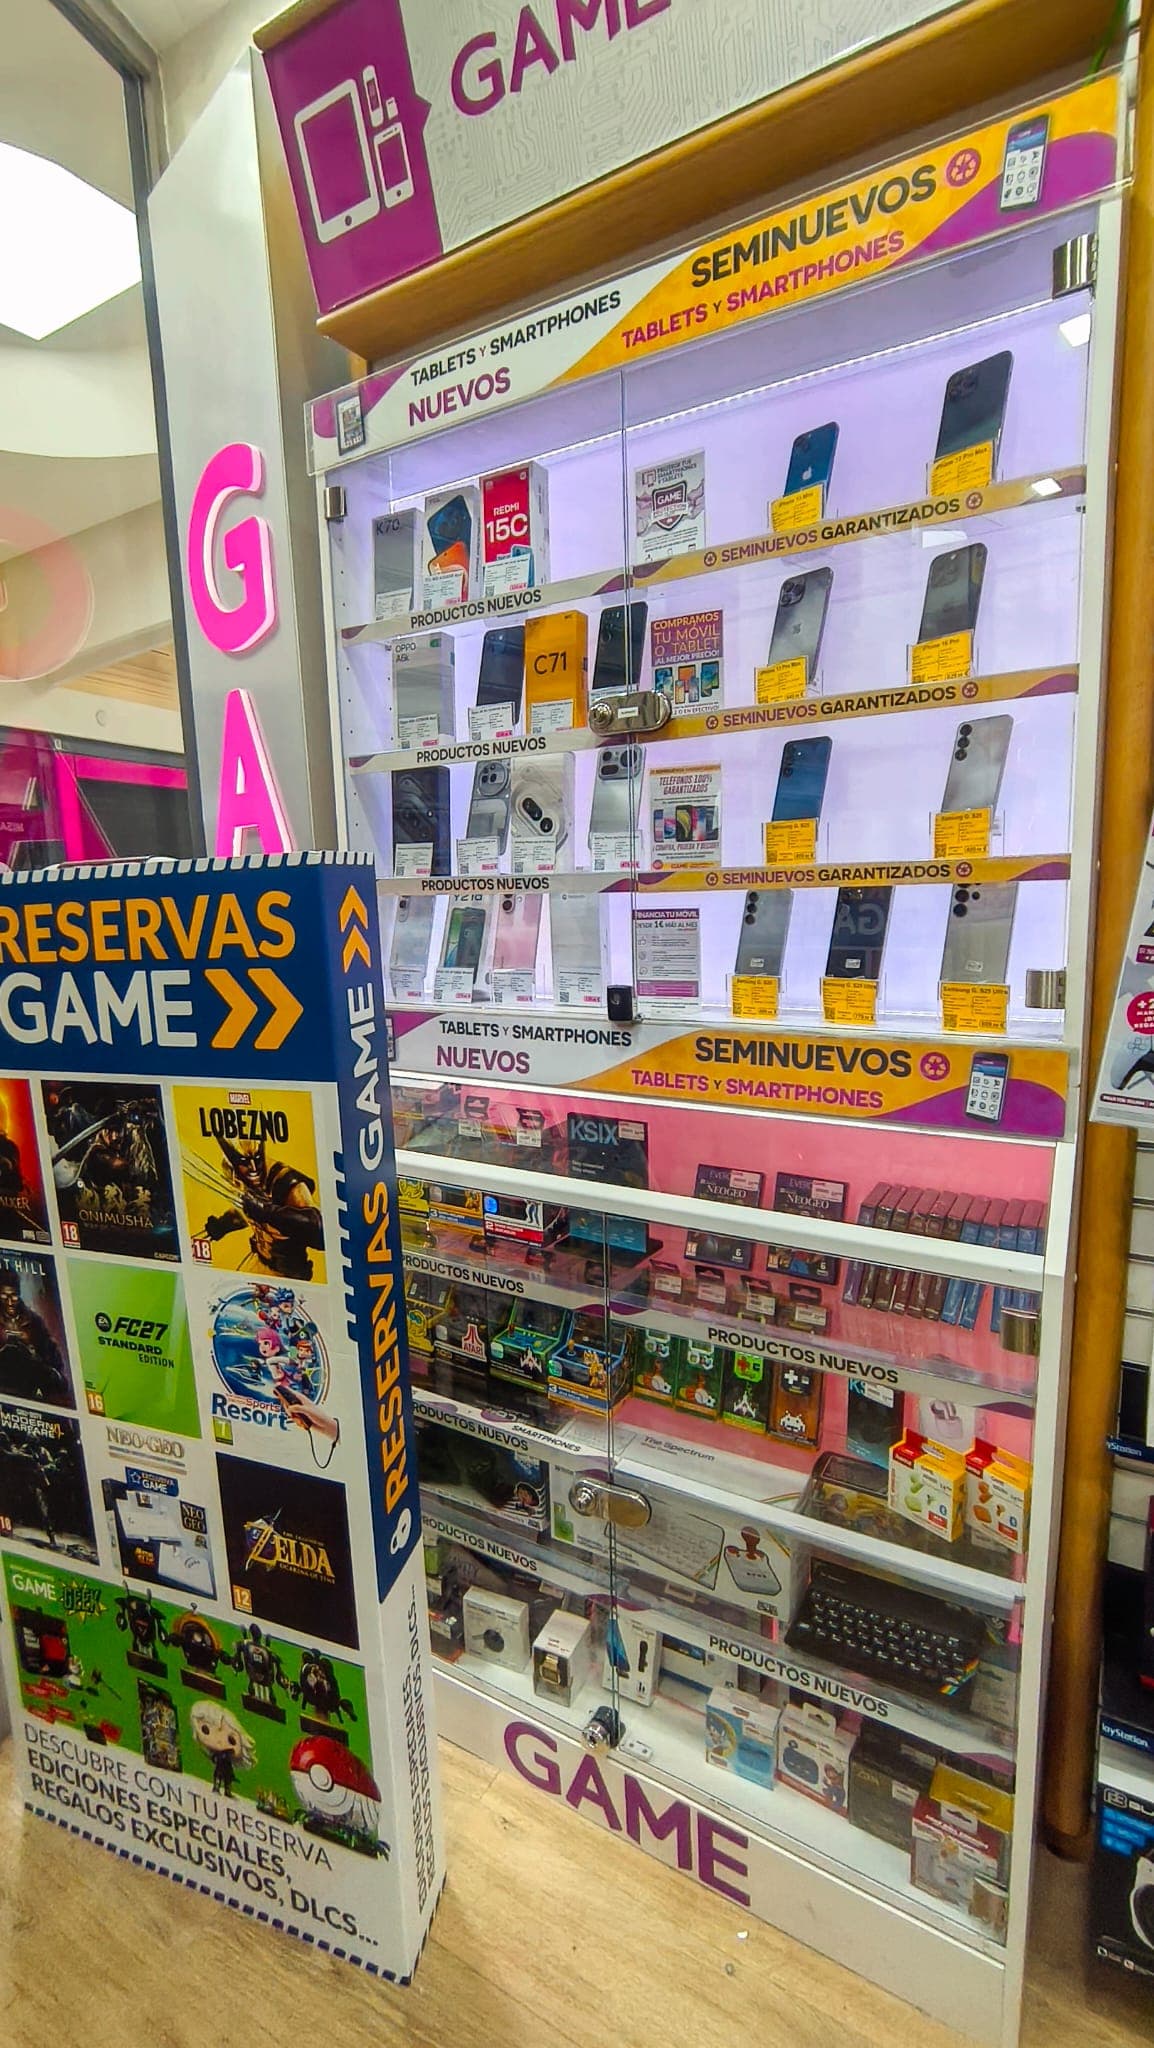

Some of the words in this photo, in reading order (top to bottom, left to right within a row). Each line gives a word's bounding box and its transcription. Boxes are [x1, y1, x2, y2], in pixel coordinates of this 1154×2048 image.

[691, 164, 937, 288] SEMINUEVOS
[621, 303, 708, 349] TABLETS
[726, 230, 905, 313] SMARTPHONES
[410, 347, 477, 387] TABLETS
[489, 290, 621, 357] SMARTPHONES
[408, 366, 511, 427] NUEVOS
[493, 502, 520, 516] REDMI
[657, 490, 683, 505] GAME
[486, 513, 529, 543] 15C
[721, 529, 818, 562] SEMINUEVOS
[821, 498, 960, 541] GARANTIZADOS
[410, 602, 485, 630] PRODUCTOS
[487, 589, 542, 613] NUEVOS
[653, 611, 719, 631] COMPRAMOS
[395, 642, 417, 653] OPPO
[655, 630, 671, 645] TU
[655, 645, 665, 657] O
[672, 636, 719, 655] TABLET
[534, 651, 568, 675] C71
[723, 703, 817, 728] SEMINUEVOS
[820, 685, 956, 715] GARANTIZADOS
[417, 745, 490, 763] PRODUCTOS
[493, 736, 546, 755] NUEVOS
[422, 877, 495, 892] PRODUCTOS
[497, 876, 550, 891] NUEVOS
[722, 870, 815, 886] SEMINUEVOS
[818, 863, 951, 882] GARANTIZADOS
[0, 890, 296, 964] RESERVAS
[0, 969, 198, 1048] GAME
[439, 1020, 500, 1038] TABLETS
[512, 1025, 632, 1047] SMARTPHONES
[436, 1045, 530, 1074] NUEVOS
[695, 1036, 911, 1078] SEMINUEVOS
[348, 982, 384, 1171] GAME
[631, 1069, 709, 1092] TABLETS
[726, 1078, 883, 1109] SMARTPHONES
[199, 1107, 289, 1144] LOBEZNO
[570, 1118, 620, 1146] KSIX
[707, 1184, 747, 1199] NEOGEO
[787, 1193, 830, 1210] NEOGEO
[63, 1223, 78, 1241] 18
[78, 1209, 154, 1229] ONIMUSHA
[195, 1239, 211, 1259] 18
[14, 1260, 46, 1276] HILL
[472, 1271, 525, 1294] NUEVOS
[114, 1316, 169, 1341] FC27
[97, 1335, 163, 1356] STANDARD
[363, 1181, 409, 1517] RESERVAS
[463, 1343, 483, 1355] ATARI
[707, 1326, 815, 1365] PRODUCTOS
[819, 1352, 898, 1384] NUEVOS
[139, 1353, 174, 1369] EDITION
[87, 1392, 104, 1413] 16
[211, 1392, 289, 1432] Resort
[246, 1398, 281, 1413] Sports
[0, 1411, 56, 1429] MODERN
[1, 1419, 56, 1438] WARFARE
[412, 1402, 476, 1434] RODUCTOS
[478, 1422, 529, 1452] NUEVOS
[511, 1424, 582, 1453] SMARTPHONES
[663, 1441, 716, 1462] Spectrum
[142, 1480, 168, 1495] GAME
[244, 1521, 336, 1580] ZELDA
[422, 1514, 484, 1550] RODUCTOS
[486, 1538, 538, 1572] NUEVOS
[12, 1573, 57, 1602] GAME
[234, 1587, 250, 1606] 12
[407, 1585, 421, 1657] DLCS...
[708, 1634, 811, 1688] PRODUCTOS
[814, 1678, 890, 1718] NUEVOS
[403, 1665, 419, 1798] ESPECIALES,
[412, 1657, 430, 1791] EXCLUSIVOS,
[1101, 1722, 1148, 1748] layStation
[25, 1723, 129, 1784] DESCUBRE
[134, 1770, 182, 1805] CON
[187, 1791, 218, 1822] TU
[226, 1807, 333, 1871] RESERVA
[28, 1749, 140, 1813] EDICIONES
[147, 1799, 292, 1885] ESPECIALES,
[504, 1721, 750, 1907] GAME
[411, 1794, 427, 1915] EDICIONES
[422, 1796, 436, 1889] REGALOS
[32, 1772, 126, 1833] REGALOS
[132, 1817, 284, 1907] EXCLUSIVOS,
[291, 1889, 379, 1947] DLCS...
